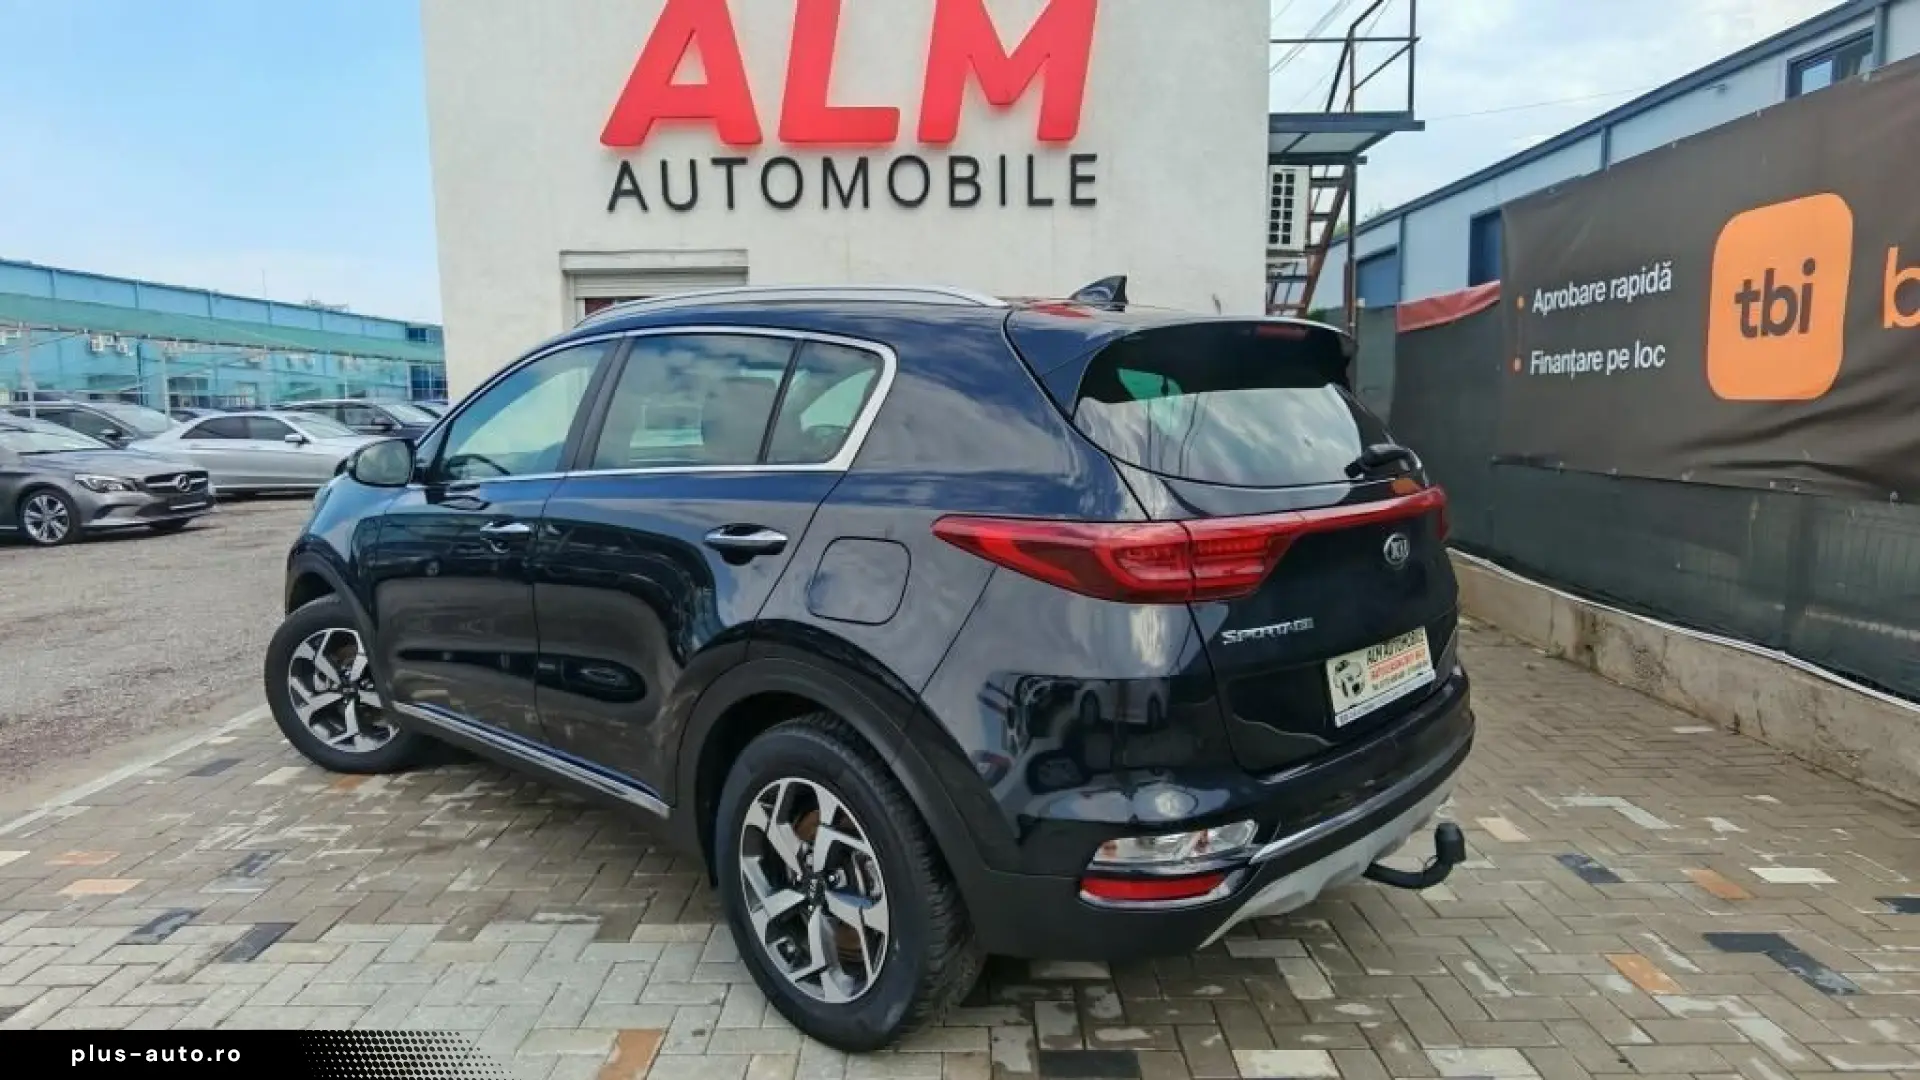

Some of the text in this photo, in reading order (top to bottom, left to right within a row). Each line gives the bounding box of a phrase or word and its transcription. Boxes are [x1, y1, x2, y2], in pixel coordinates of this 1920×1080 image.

[600, 0, 1098, 147] ALM
[606, 153, 1098, 212] AUTOMOBILE
[1531, 260, 1673, 317] Aprobare rapidă
[1733, 257, 1816, 339] tbi
[1606, 348, 1630, 376] pe
[1634, 339, 1666, 369] loc
